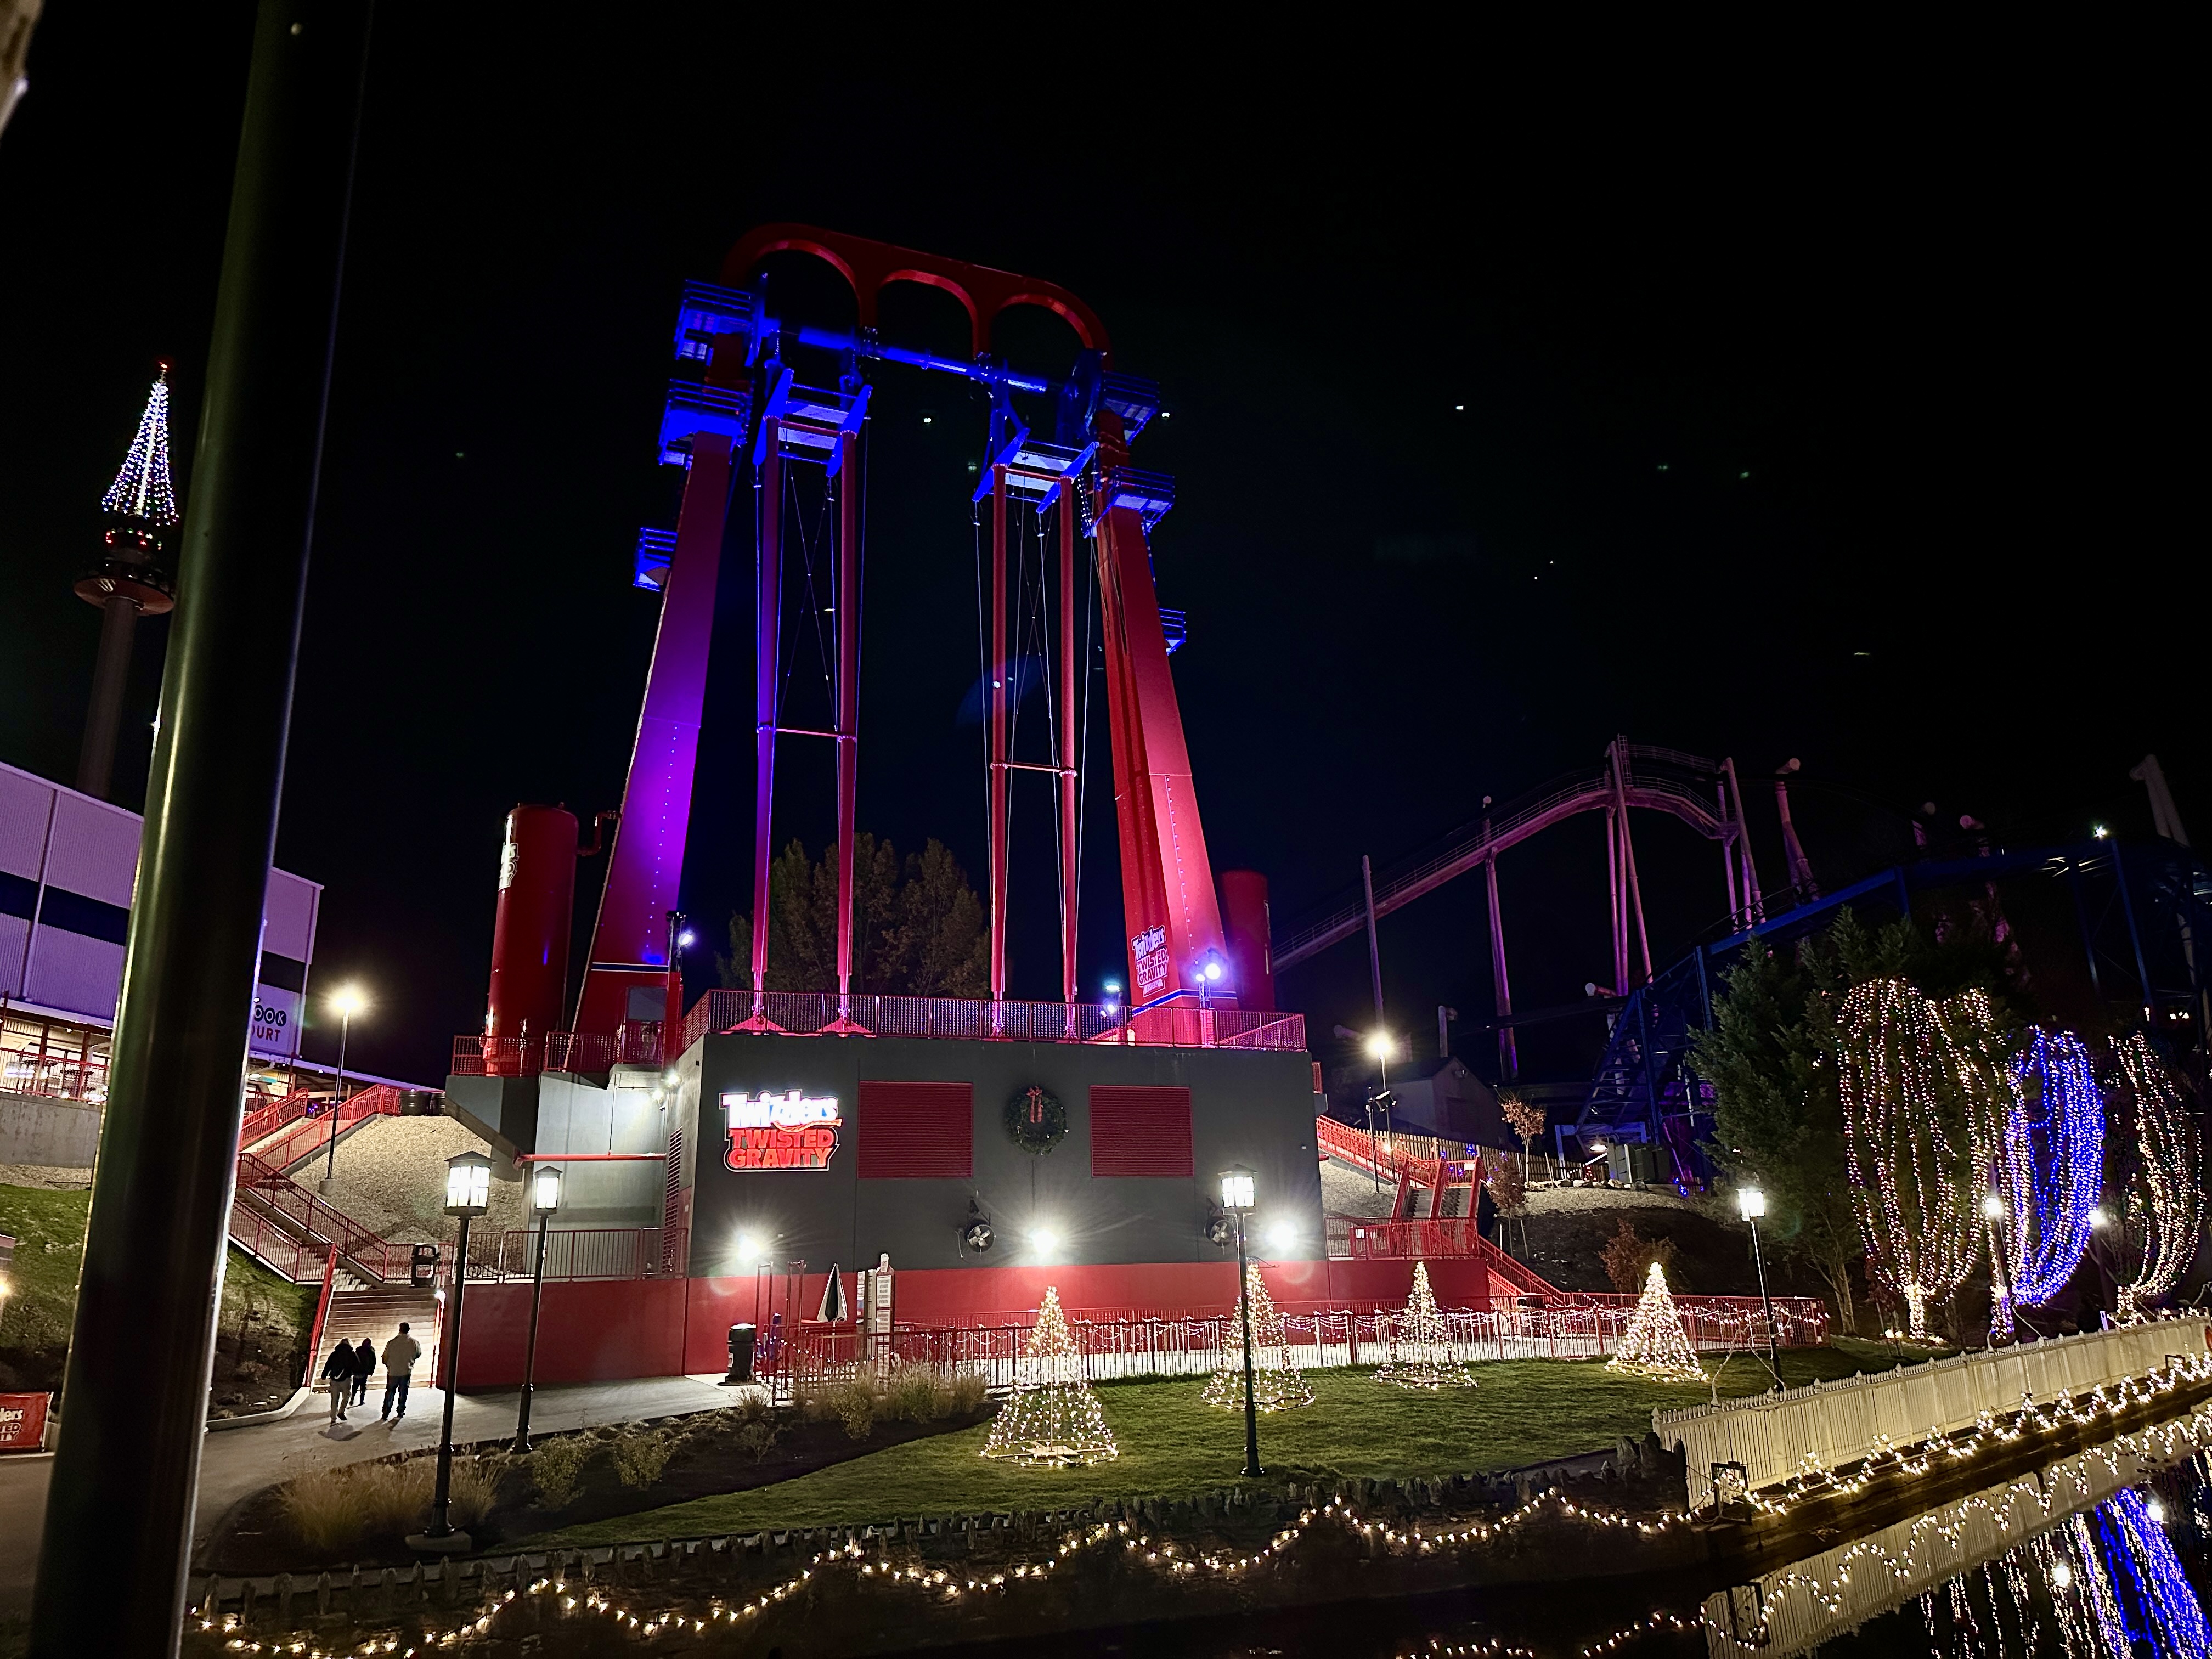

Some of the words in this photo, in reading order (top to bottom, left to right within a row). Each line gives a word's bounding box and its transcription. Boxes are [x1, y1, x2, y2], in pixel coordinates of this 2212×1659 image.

[1137, 950, 1166, 973] TWISTED
[1138, 962, 1166, 984] GRAVITY
[729, 1129, 834, 1149] TWISTED
[728, 1148, 833, 1168] GRAVITY
